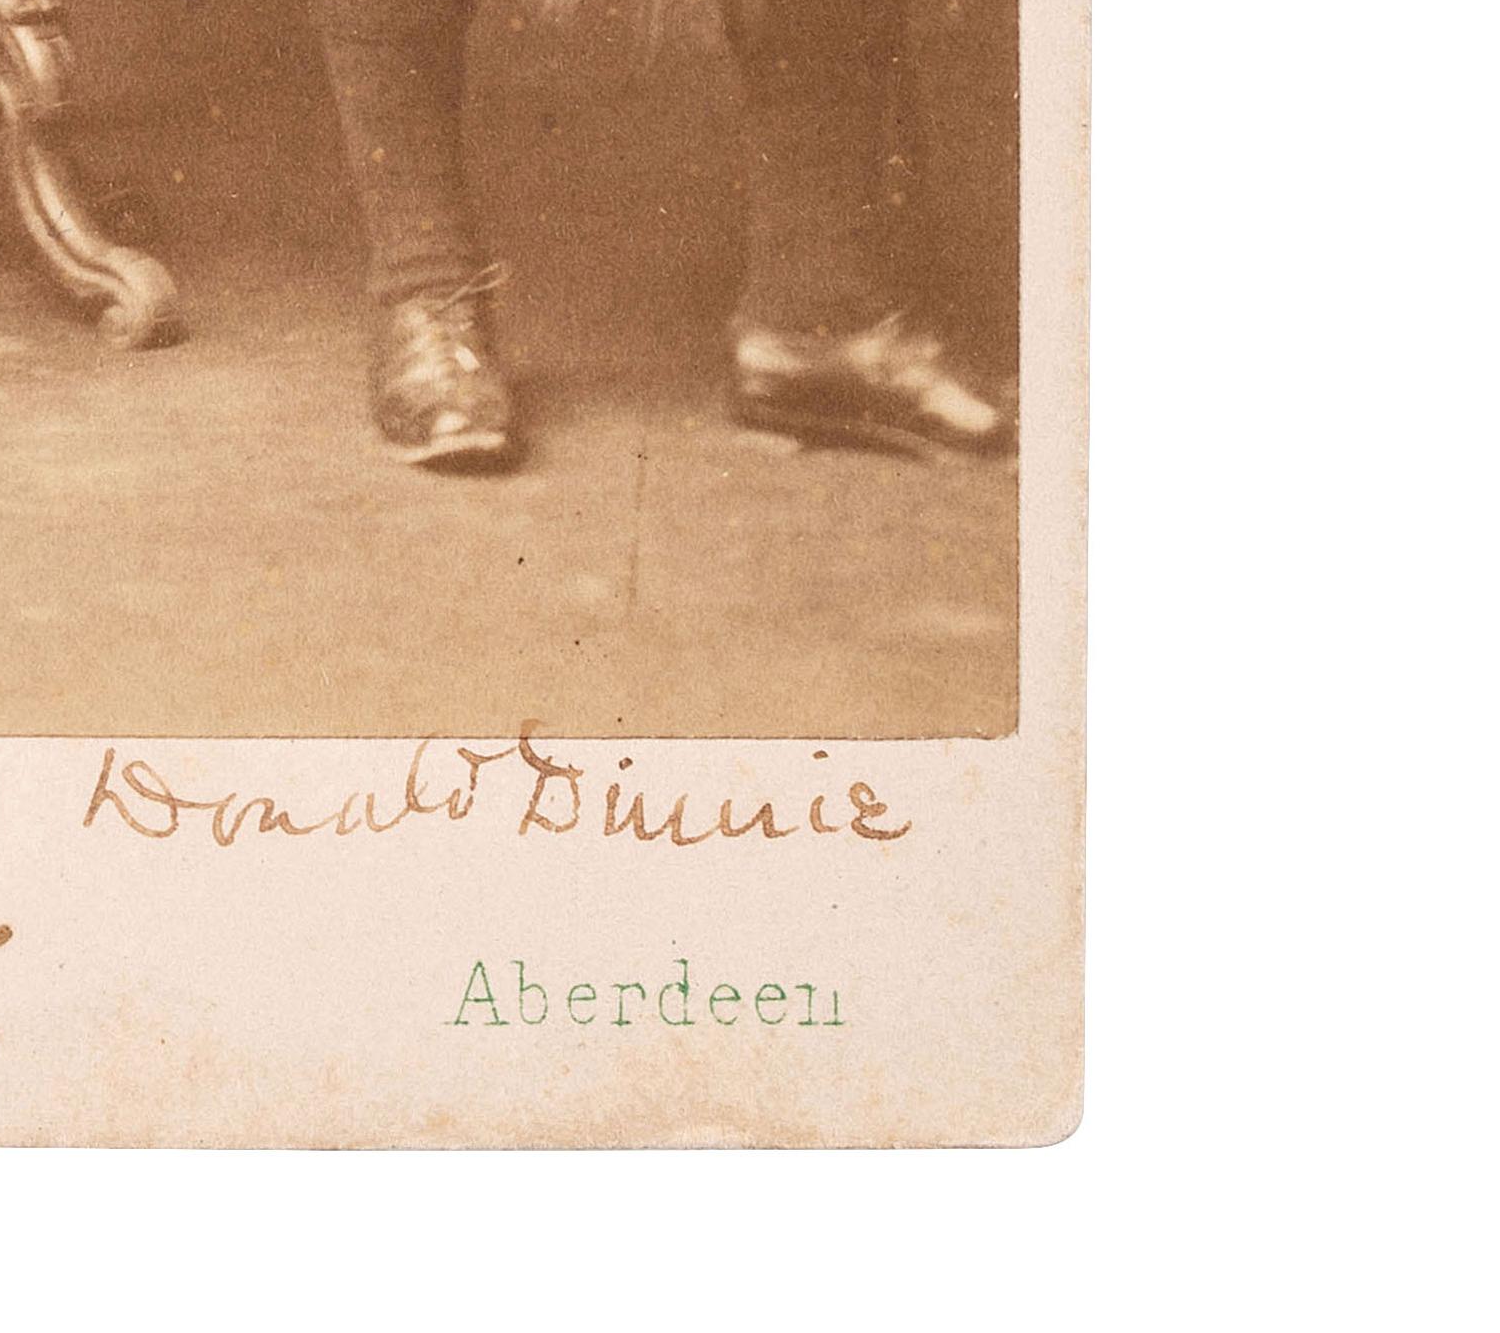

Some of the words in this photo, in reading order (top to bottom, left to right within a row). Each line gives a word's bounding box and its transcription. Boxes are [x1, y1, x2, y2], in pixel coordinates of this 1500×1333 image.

[81, 729, 514, 848] Donald
[516, 717, 914, 847] Dinnie
[442, 957, 846, 1027] Aberdeen
